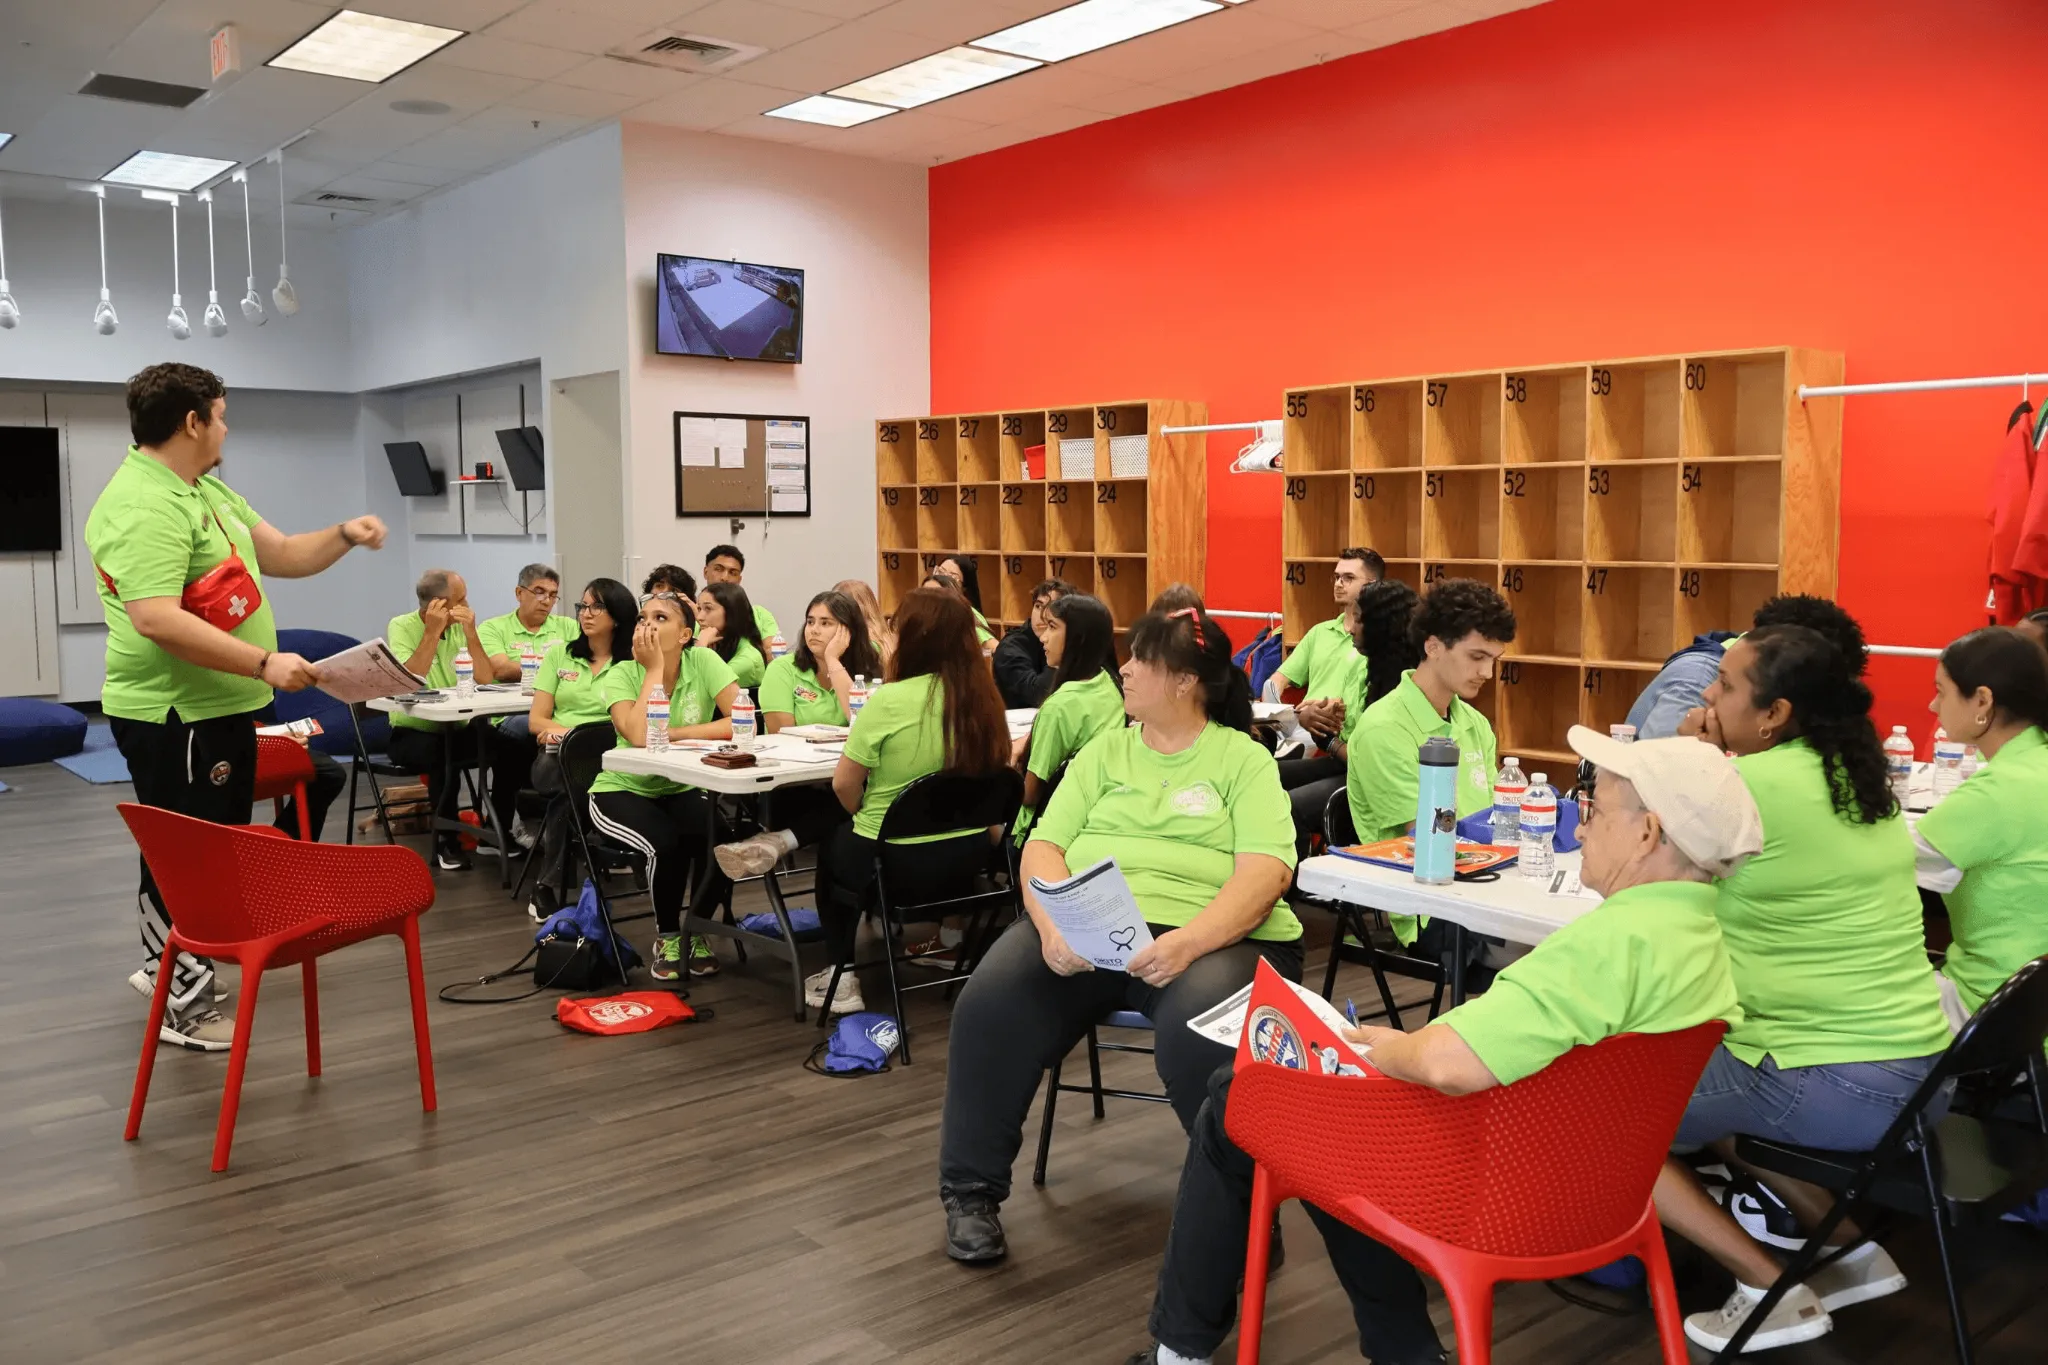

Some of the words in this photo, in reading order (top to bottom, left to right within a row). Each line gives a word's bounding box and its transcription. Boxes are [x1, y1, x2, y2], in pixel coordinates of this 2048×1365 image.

[1591, 369, 1611, 396] 59
[1685, 364, 1706, 390] 60
[1354, 388, 1375, 412] 56
[1427, 383, 1448, 407] 57
[1505, 377, 1526, 402] 58
[1287, 395, 1307, 417] 55
[960, 420, 979, 438] 27
[1002, 417, 1022, 436] 28
[1048, 413, 1068, 433] 29
[1097, 410, 1116, 430] 30
[880, 425, 899, 443] 25
[919, 422, 938, 440] 26
[1286, 478, 1306, 500] 49
[1354, 476, 1374, 499] 50
[1426, 473, 1444, 497] 51
[1504, 471, 1526, 497] 52
[1588, 468, 1610, 495] 53
[1682, 465, 1701, 493] 54
[882, 488, 898, 506] 19
[919, 487, 938, 506] 20
[960, 488, 977, 506] 21
[1002, 486, 1023, 505] 22
[1048, 485, 1068, 504] 23
[1097, 484, 1116, 503] 24
[882, 553, 899, 571] 13
[922, 553, 937, 571] 14
[1004, 556, 1022, 574] 16
[1049, 558, 1066, 576] 17
[1098, 559, 1116, 579] 18
[1286, 564, 1306, 586] 43
[1424, 564, 1445, 583] 45
[1502, 568, 1523, 592] 46
[1587, 569, 1608, 595] 47
[1679, 571, 1700, 597] 48
[1500, 662, 1520, 685] 40
[1584, 670, 1602, 694] 41
